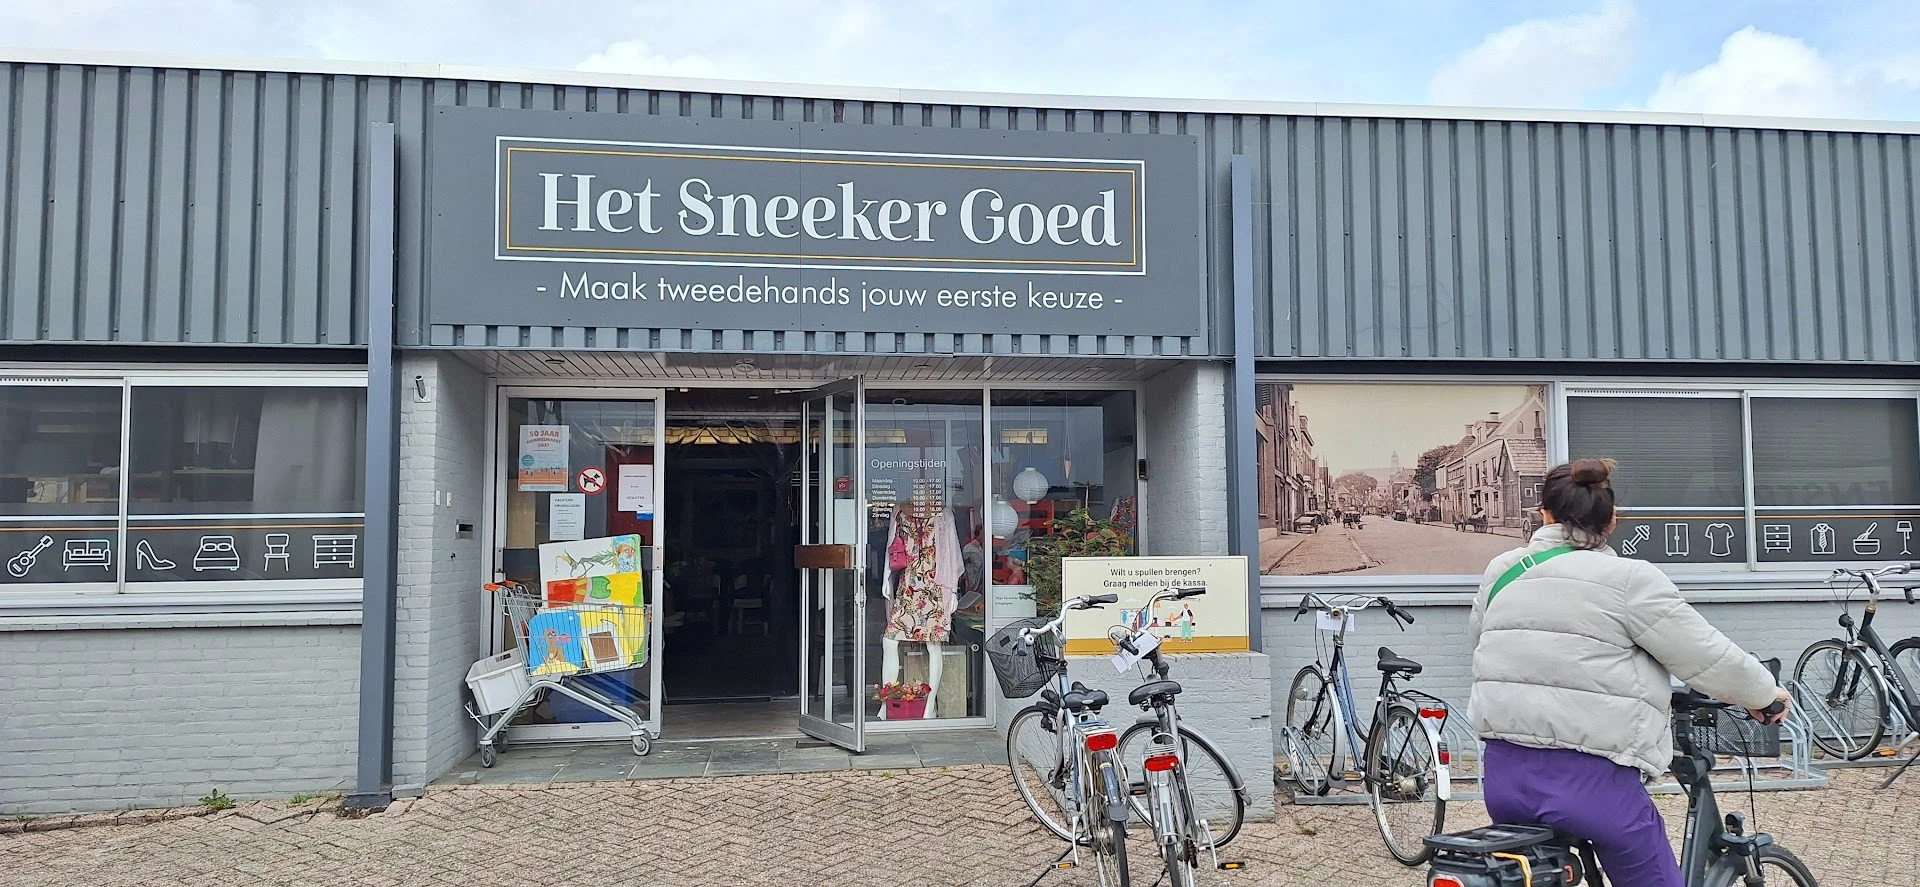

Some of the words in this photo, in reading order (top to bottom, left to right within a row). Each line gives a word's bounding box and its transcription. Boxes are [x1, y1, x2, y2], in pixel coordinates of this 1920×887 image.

[538, 172, 663, 234] Het
[677, 177, 946, 242] Sneeker
[959, 188, 1122, 247] Goed
[559, 271, 648, 301] Maak
[657, 275, 851, 305] tweedehands
[861, 281, 927, 313] jouw
[937, 284, 1017, 308] eerste
[1028, 281, 1104, 310] keuze
[540, 430, 560, 438] JAAR
[871, 459, 946, 470] Openingstijden
[1110, 568, 1126, 576] Wilt
[1135, 568, 1163, 577] spullen
[1165, 568, 1201, 577] brengen?
[1103, 579, 1127, 588] Graag
[1129, 579, 1158, 587] melden
[1160, 579, 1169, 588] bij
[1171, 579, 1181, 587] de
[1183, 579, 1208, 587] kassa.
